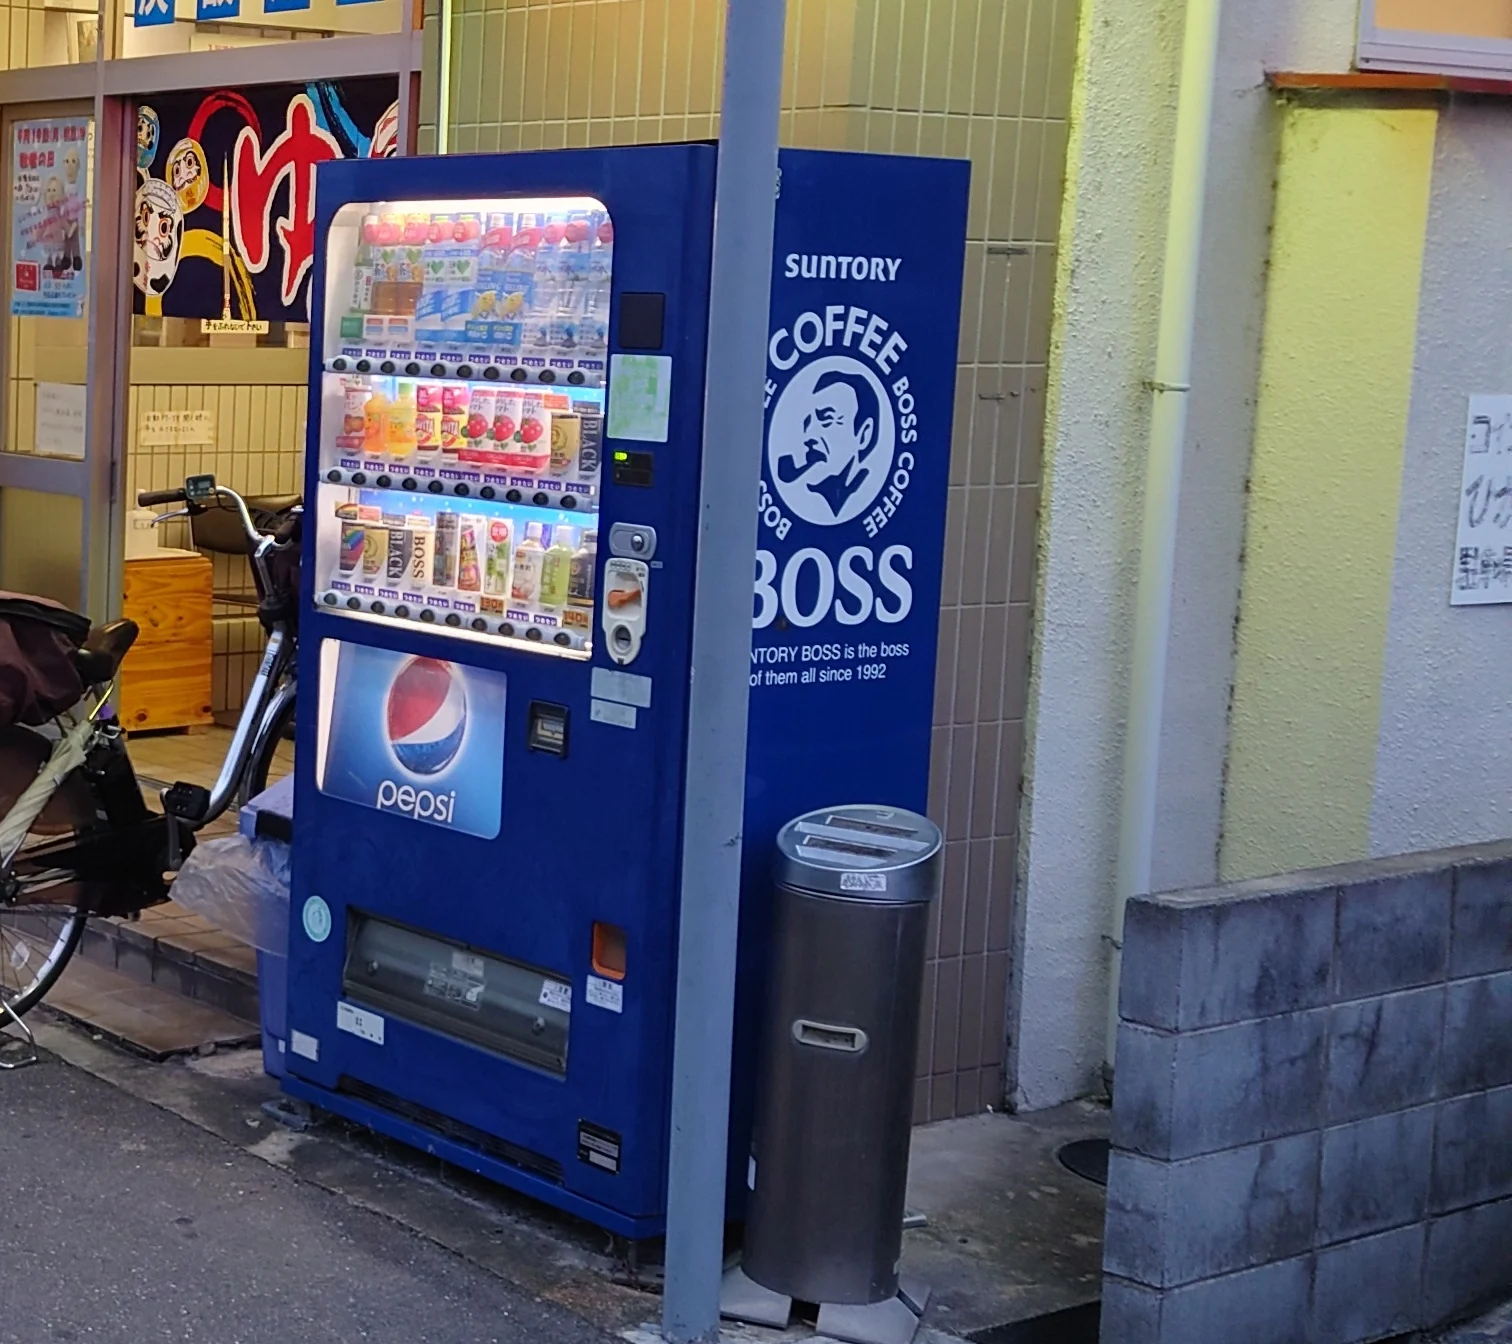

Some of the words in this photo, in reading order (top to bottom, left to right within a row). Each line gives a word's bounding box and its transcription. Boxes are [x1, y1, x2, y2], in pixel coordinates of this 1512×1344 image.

[785, 253, 902, 281] SUNTORY
[769, 304, 908, 376] COFFEE
[892, 375, 918, 444] BOSS
[581, 420, 598, 471] BLACK
[862, 451, 916, 538] COFFEE
[389, 530, 404, 579] BLACK
[413, 536, 425, 578] BOSS
[752, 545, 913, 629] BOSS
[749, 669, 763, 686] of
[765, 670, 798, 686] them
[801, 668, 816, 683] all
[819, 666, 852, 682] since
[856, 663, 887, 680] 1992
[801, 644, 841, 662] BOSS
[844, 644, 855, 659] is
[858, 642, 877, 658] the
[881, 641, 910, 657] boss
[376, 779, 457, 824] pepsi
